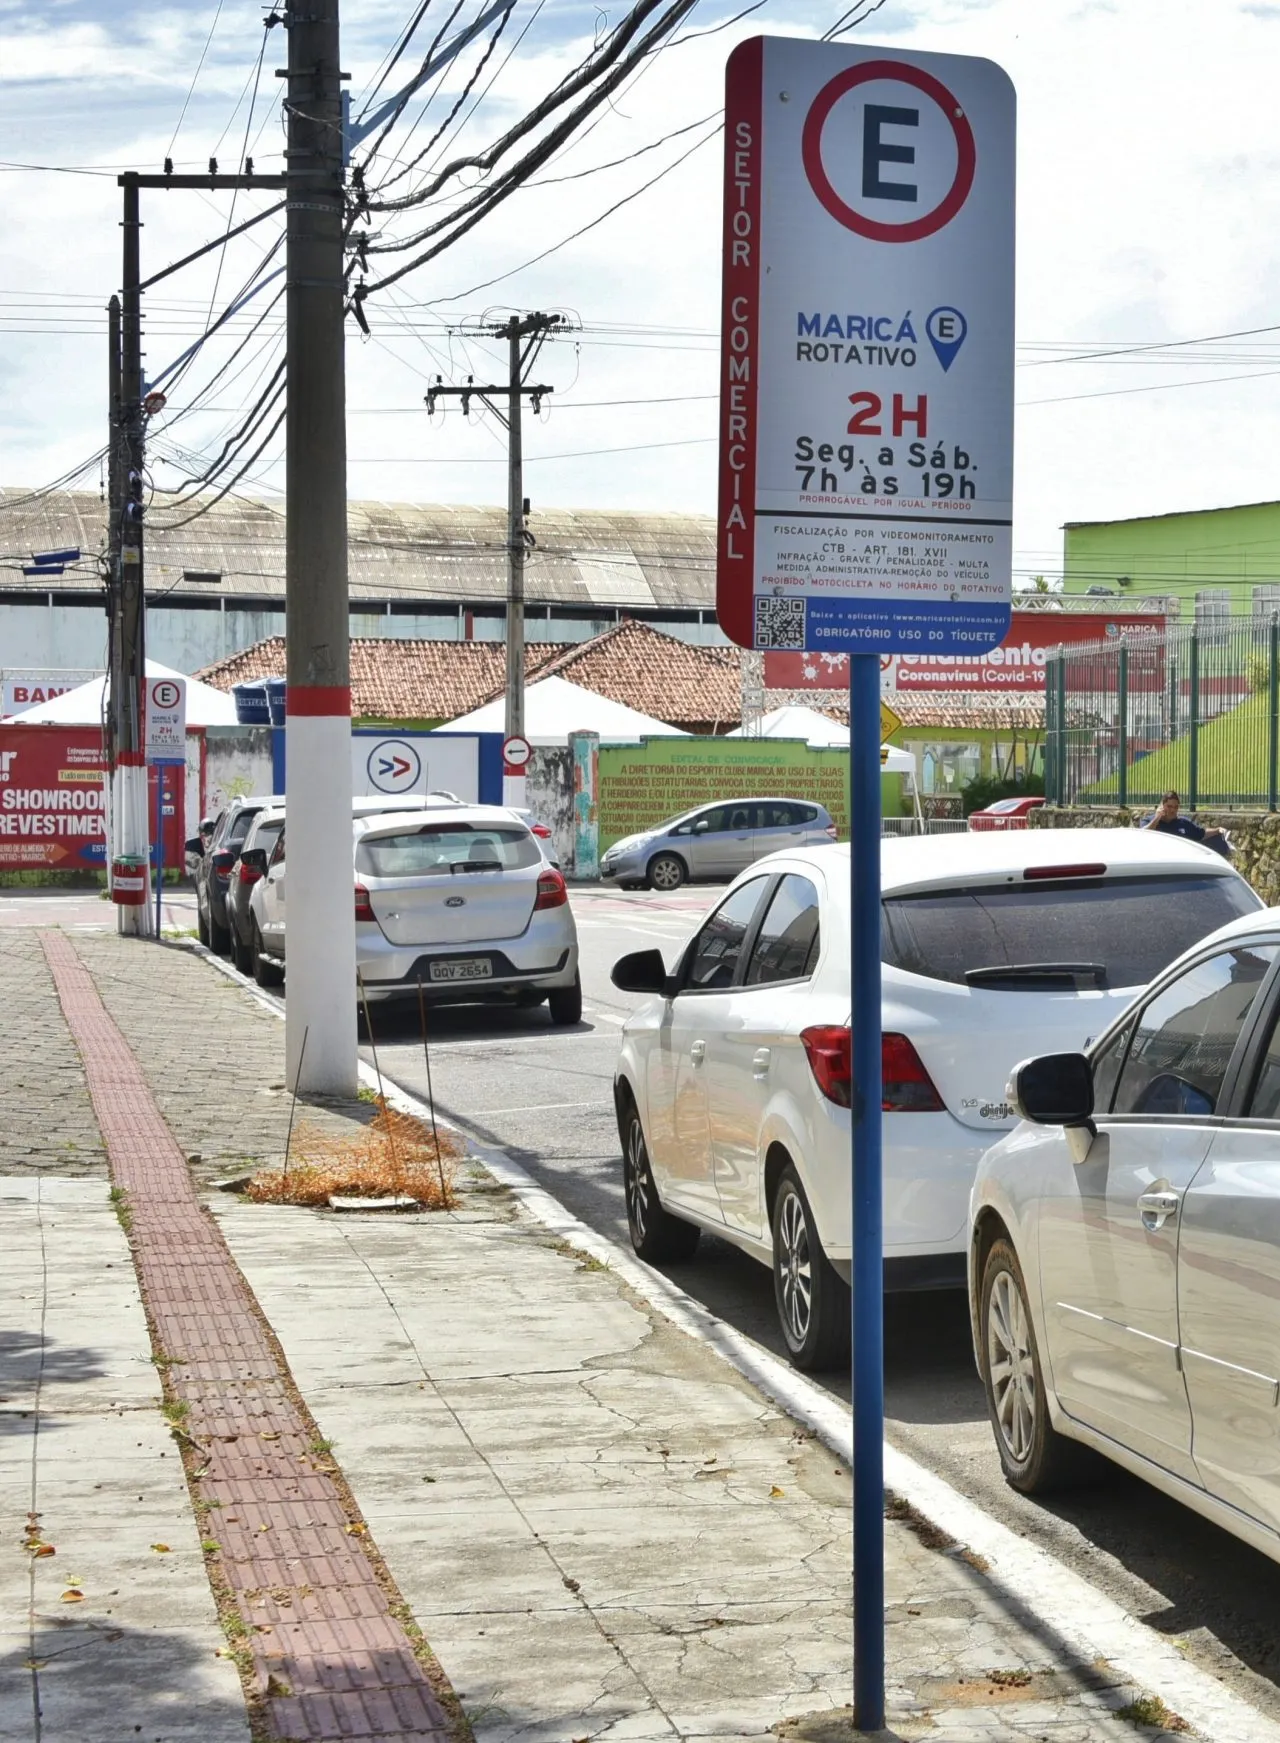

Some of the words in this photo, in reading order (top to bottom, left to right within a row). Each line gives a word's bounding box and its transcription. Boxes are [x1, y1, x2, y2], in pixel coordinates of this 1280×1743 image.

[862, 103, 920, 203] E
[731, 122, 752, 267] SETOR
[797, 309, 918, 344] MARICÁ
[938, 317, 955, 338] E
[796, 341, 917, 368] ROTATIVO
[847, 391, 928, 438] 2H
[725, 297, 749, 560] COMERCIAL
[794, 436, 865, 473] Seg.
[878, 446, 894, 466] a
[907, 440, 979, 471] Sáb.
[795, 465, 838, 493] 7h
[860, 465, 899, 496] às
[921, 471, 976, 499] 19h
[799, 495, 868, 506] PRORROGÁVEL
[874, 499, 892, 507] POR
[898, 500, 926, 509] IGUAL
[931, 501, 972, 511] PERÍODO
[774, 525, 848, 539] FISCALIZAÇÃO
[854, 529, 875, 538] POR
[880, 530, 994, 544] VIDEOMONITORAMENTO
[777, 551, 826, 563] INFRAÇÃO
[839, 555, 871, 564] GRAVE
[886, 557, 945, 567] PENALIDADE
[958, 560, 990, 569] MULTA
[822, 543, 845, 554] CTB
[863, 545, 890, 556] ART.
[924, 548, 947, 558] XVII
[777, 563, 811, 573] MEDIDA
[937, 569, 949, 578] DO
[954, 569, 990, 579] VEÍCULO
[761, 575, 805, 586] PROIBIDO
[811, 578, 873, 588] MOTOCICLETA
[879, 581, 892, 589] NO
[898, 581, 938, 592] HORÁRIO
[943, 583, 956, 592] DO
[961, 584, 1004, 594] ROTATIVO
[815, 625, 891, 639] OBRIGATÓRIO
[898, 630, 922, 640] USO
[928, 631, 944, 641] DO
[14, 687, 71, 703] BAN
[162, 688, 171, 702] E
[0, 814, 107, 835] REVESTIMEN
